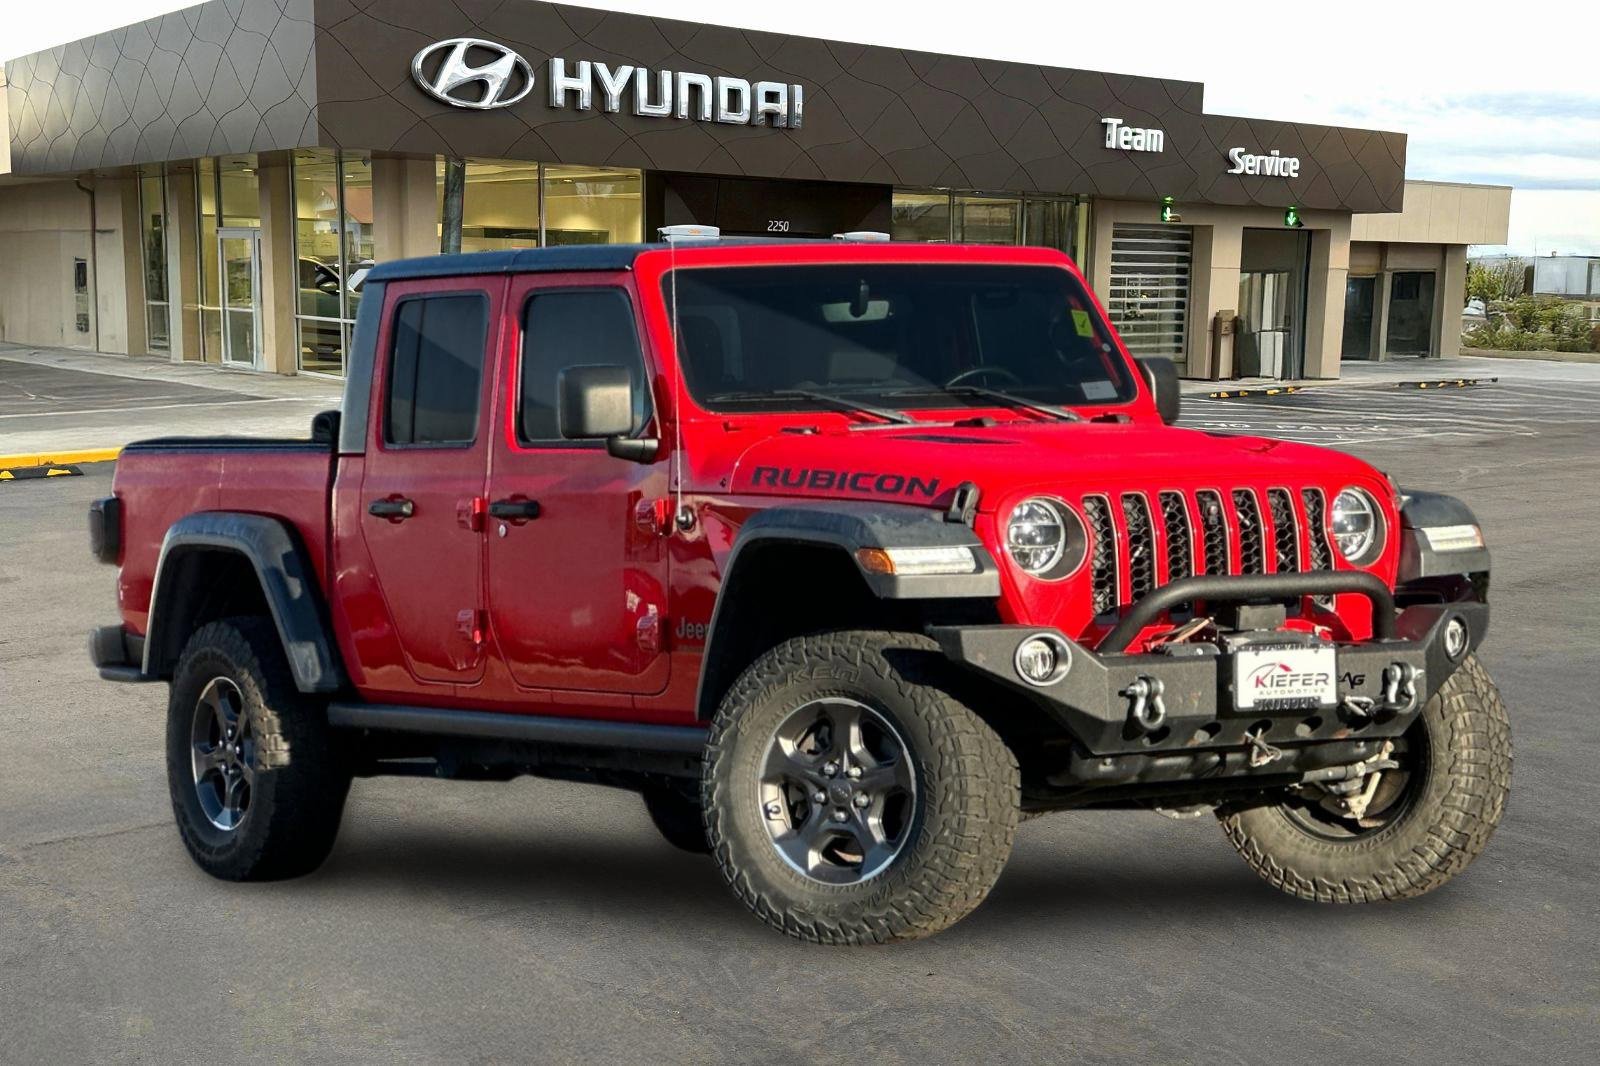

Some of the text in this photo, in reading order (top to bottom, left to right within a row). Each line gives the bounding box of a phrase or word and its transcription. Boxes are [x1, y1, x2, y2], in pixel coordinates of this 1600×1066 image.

[549, 57, 803, 129] HYUNDAI
[1102, 117, 1164, 152] Team
[1228, 147, 1300, 178] Service
[767, 220, 789, 232] 2250
[752, 466, 940, 497] RUBICON
[1255, 672, 1330, 689] KIEFER
[1259, 688, 1326, 697] AUTOMOTIVE
